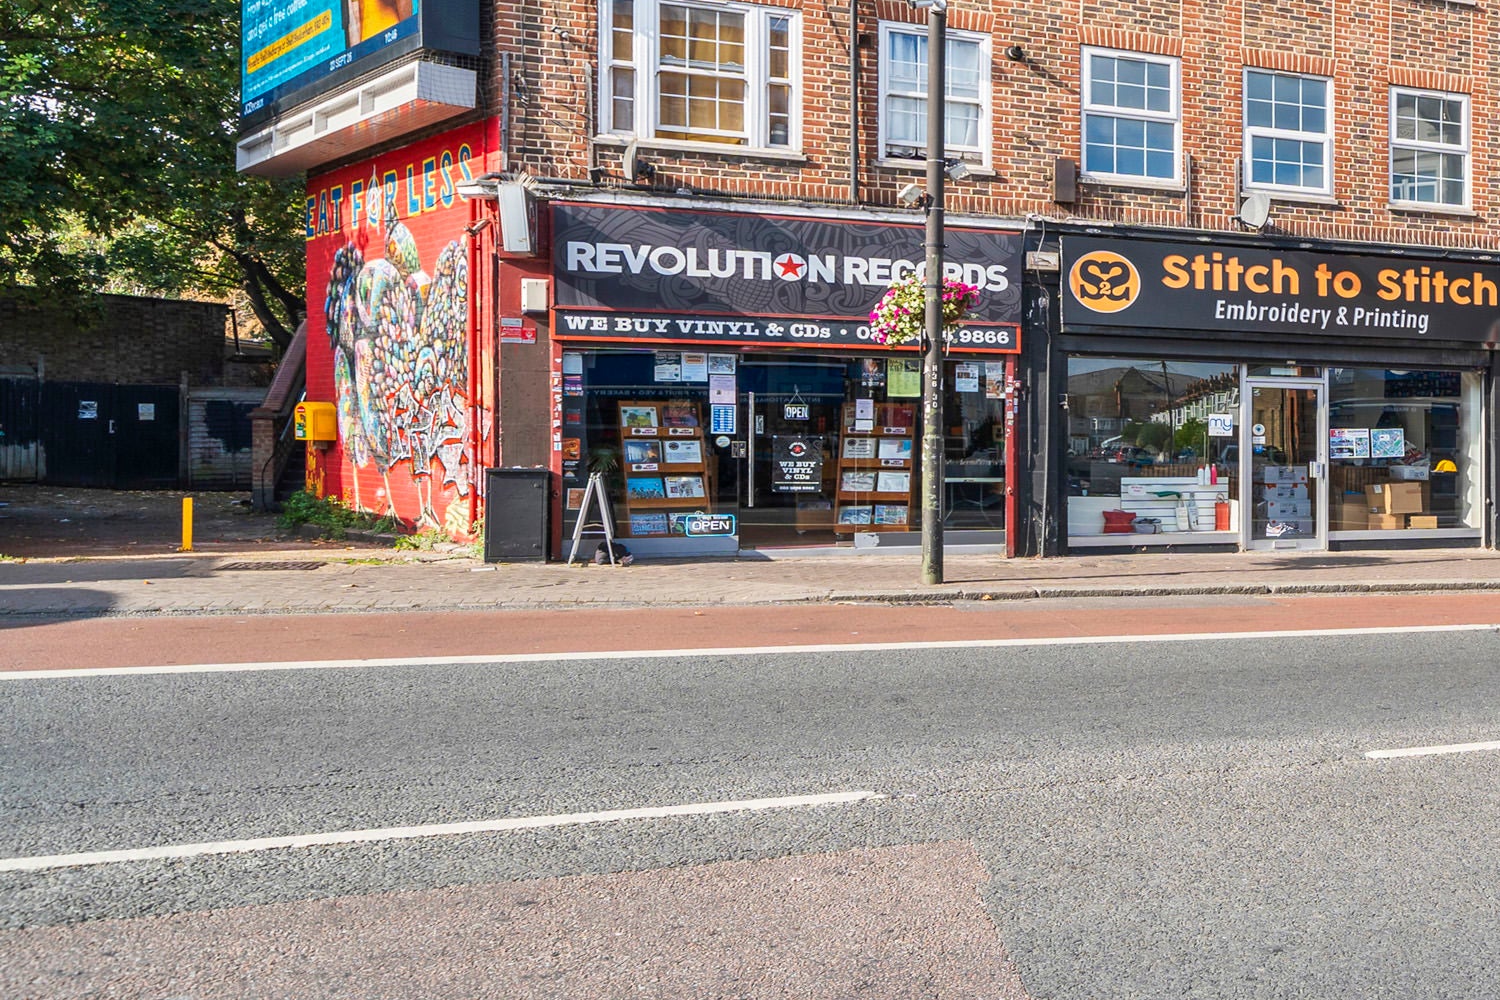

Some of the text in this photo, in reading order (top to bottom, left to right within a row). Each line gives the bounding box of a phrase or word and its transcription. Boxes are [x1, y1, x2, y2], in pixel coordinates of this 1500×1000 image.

[247, 19, 258, 42] and
[273, 7, 286, 26] free
[305, 143, 473, 241] EAT FOR LESS
[567, 241, 836, 283] REVOLUTION
[1161, 252, 1498, 307] Stitch to Stitch
[564, 315, 608, 331] WE
[614, 317, 670, 333] BUY
[675, 320, 760, 336] VINYL
[765, 322, 785, 337] &
[789, 324, 831, 338] CDs
[959, 330, 1009, 344] 9866
[1215, 299, 1429, 334] Embroidery & Printing
[786, 407, 809, 418] OPEN
[1210, 418, 1232, 431] my
[692, 521, 730, 530] OPEN
